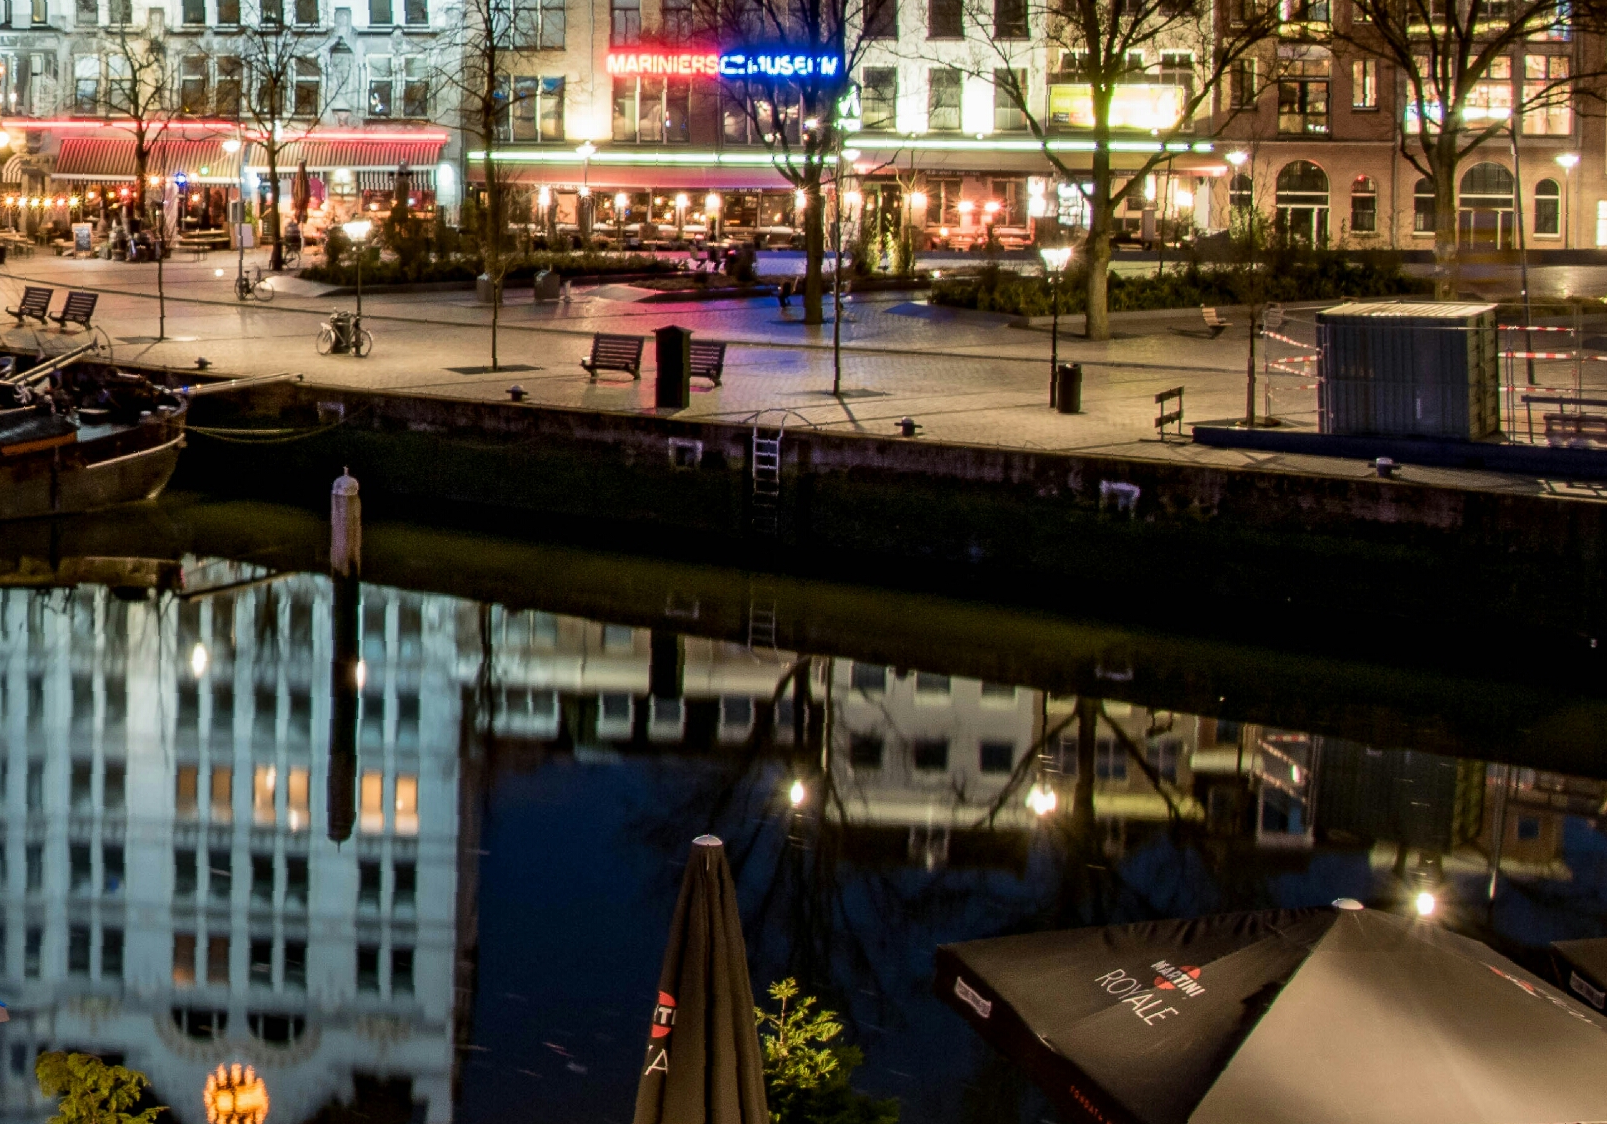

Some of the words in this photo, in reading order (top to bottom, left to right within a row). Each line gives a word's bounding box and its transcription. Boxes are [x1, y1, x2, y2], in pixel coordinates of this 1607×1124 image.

[606, 53, 719, 75] MARINIERS
[1094, 968, 1180, 1026] ROYALE
[1150, 959, 1206, 998] MARTINI
